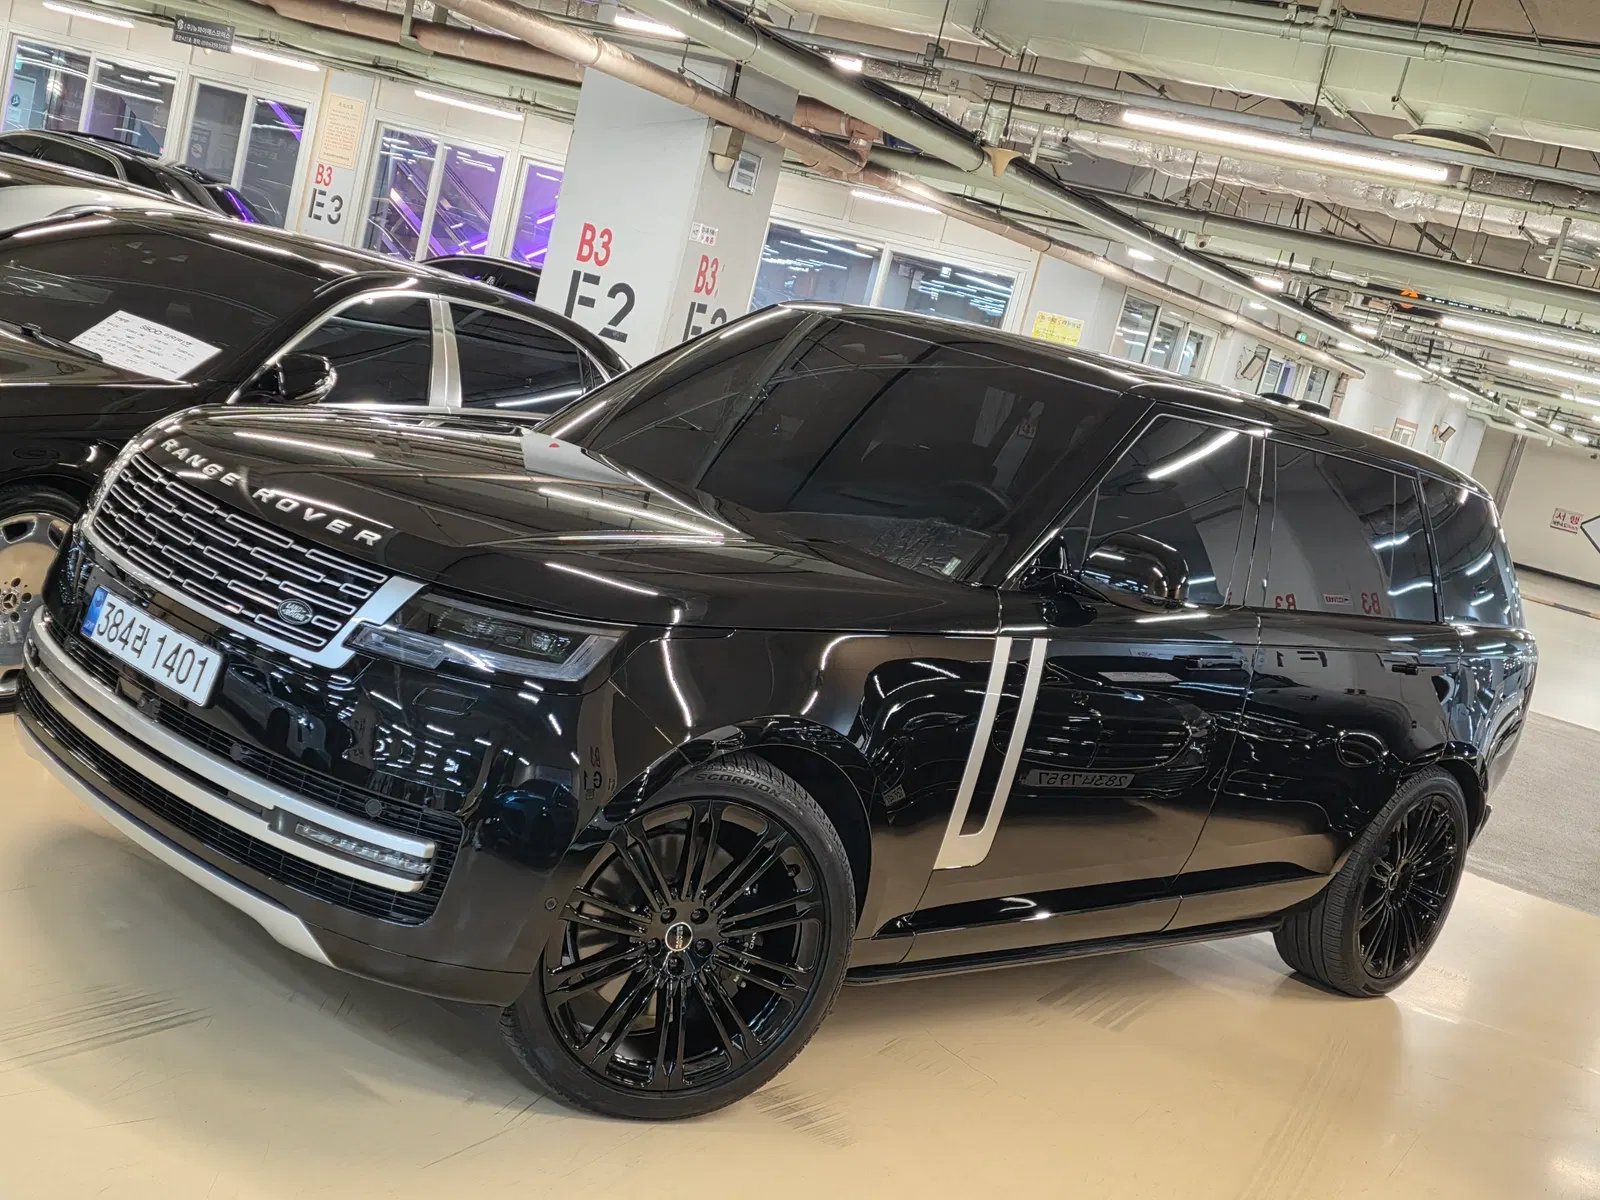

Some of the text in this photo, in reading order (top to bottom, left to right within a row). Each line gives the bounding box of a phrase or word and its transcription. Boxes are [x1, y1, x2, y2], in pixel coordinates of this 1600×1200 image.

[315, 163, 333, 187] B3
[308, 187, 343, 225] E3
[576, 222, 613, 267] B3
[693, 254, 719, 296] B3
[160, 438, 382, 546] RANGE ROVER
[151, 634, 209, 693] 1401
[696, 773, 782, 798] SCORPION
